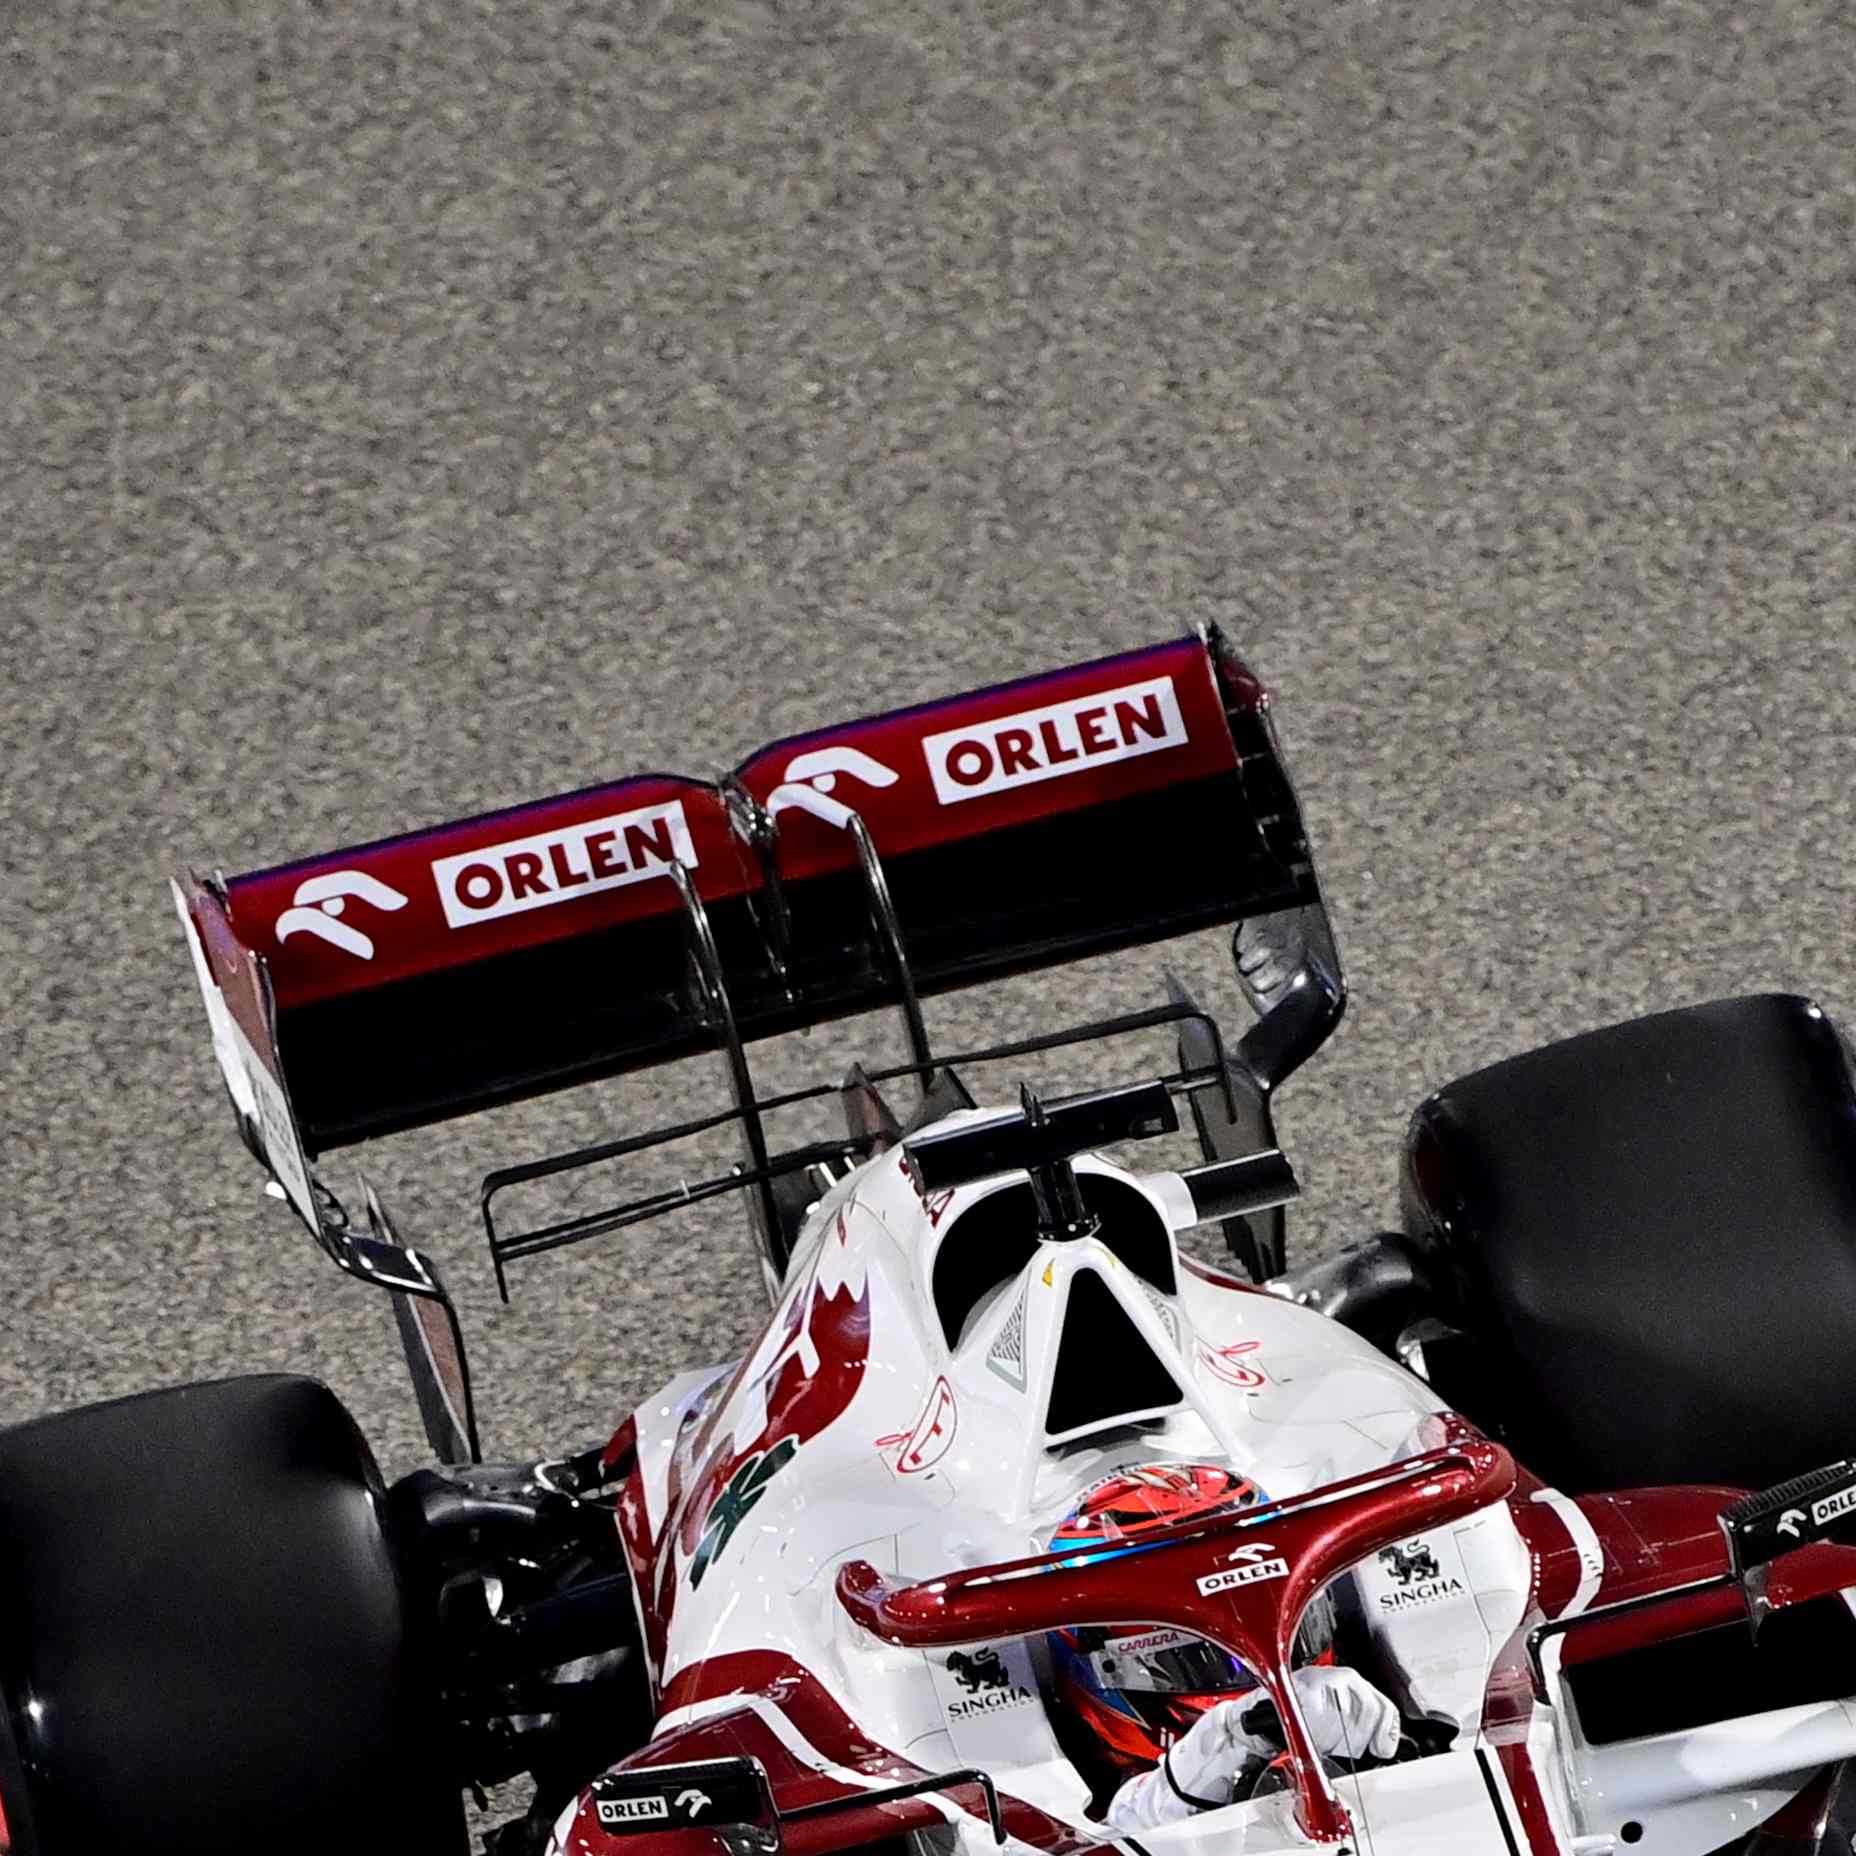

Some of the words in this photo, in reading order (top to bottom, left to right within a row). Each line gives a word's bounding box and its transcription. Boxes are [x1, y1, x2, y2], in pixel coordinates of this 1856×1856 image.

[945, 693, 1167, 785] ORLEN
[454, 817, 675, 910] ORLEN
[1205, 1563, 1282, 1589] ORLEN
[1379, 1578, 1463, 1608] SINGHA
[1118, 1631, 1179, 1652] CARRERA
[948, 1686, 1031, 1717] SINGHA
[601, 1800, 662, 1819] ORLEN
